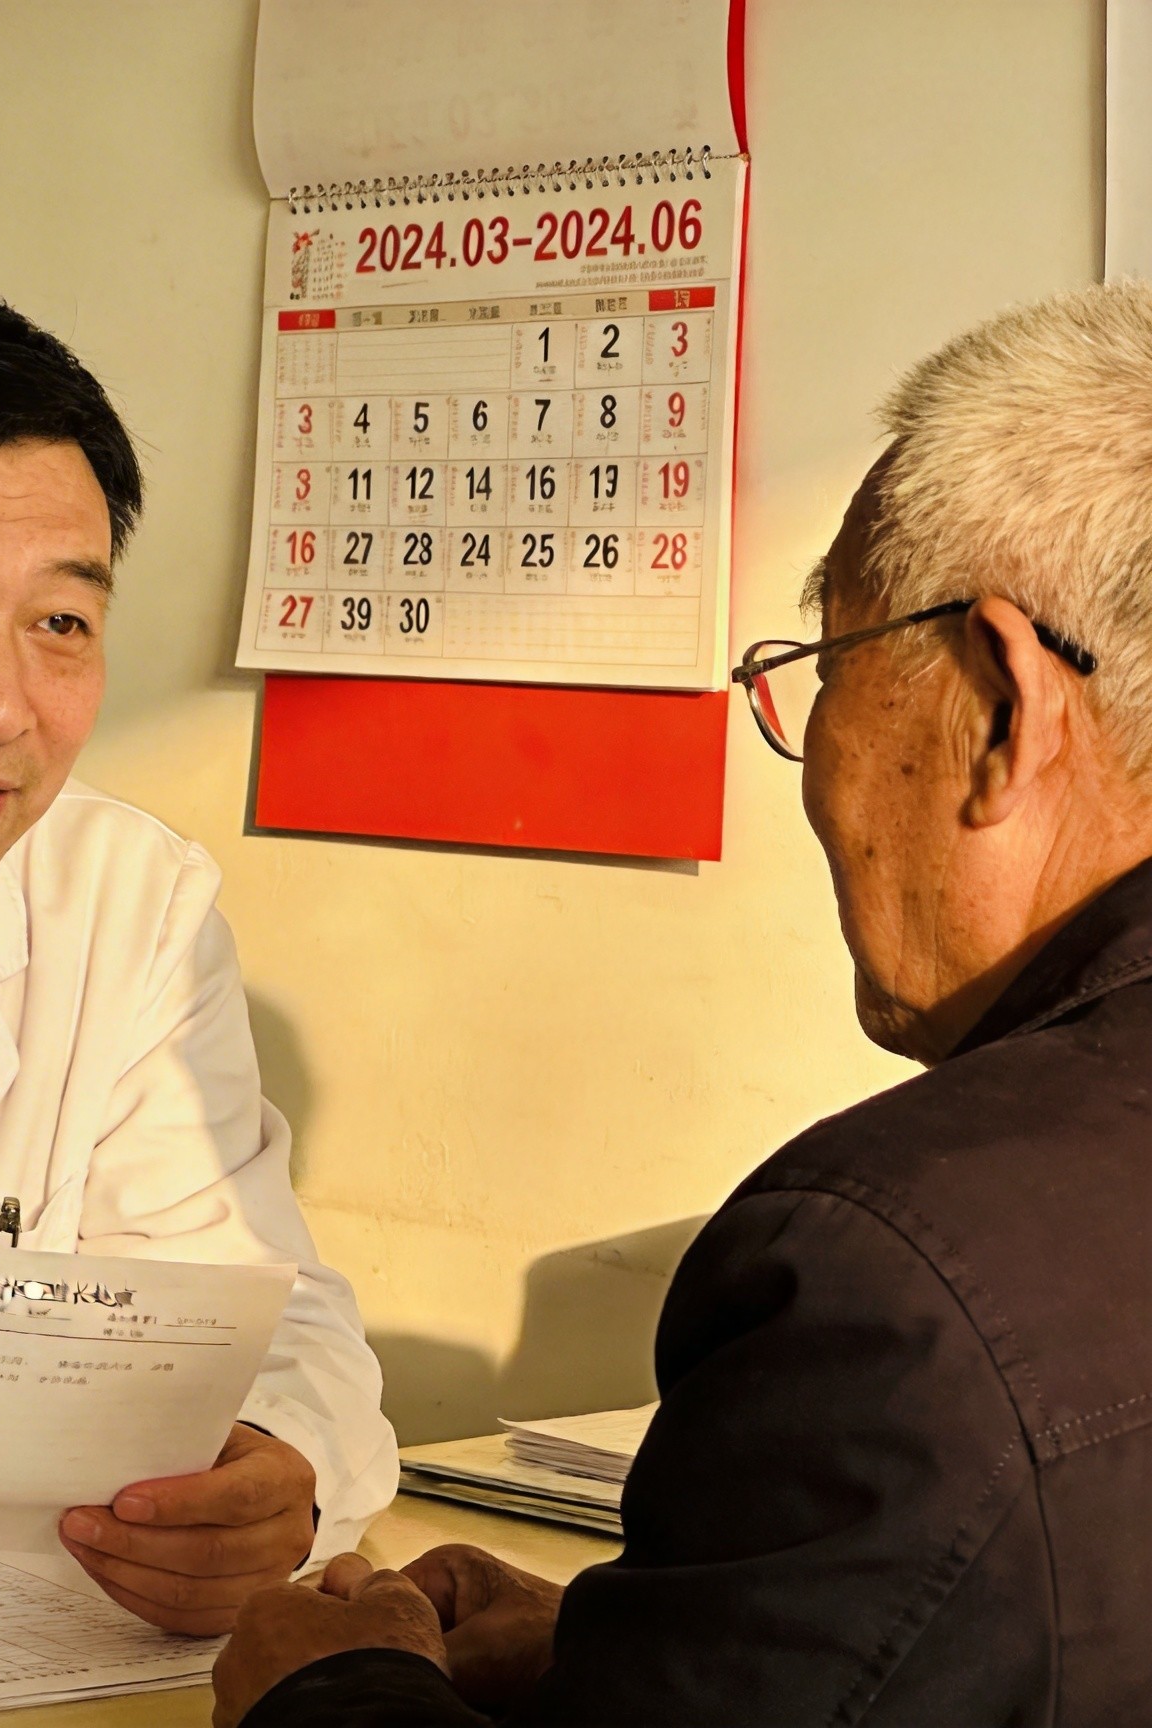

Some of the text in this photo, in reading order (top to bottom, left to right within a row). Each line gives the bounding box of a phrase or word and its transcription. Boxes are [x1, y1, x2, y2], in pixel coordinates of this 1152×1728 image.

[356, 199, 703, 273] 2024.03-2024.06
[538, 321, 688, 363] 1 2 3
[298, 391, 686, 435] 3 4 5 6 7 8 9
[347, 467, 372, 501] 11
[405, 466, 434, 500] 12
[465, 465, 493, 501] 14
[525, 464, 556, 501] 16
[658, 460, 690, 499] 19
[285, 530, 688, 571] 16 27 28 24 25 26 28
[278, 594, 430, 634] 27 39 30
